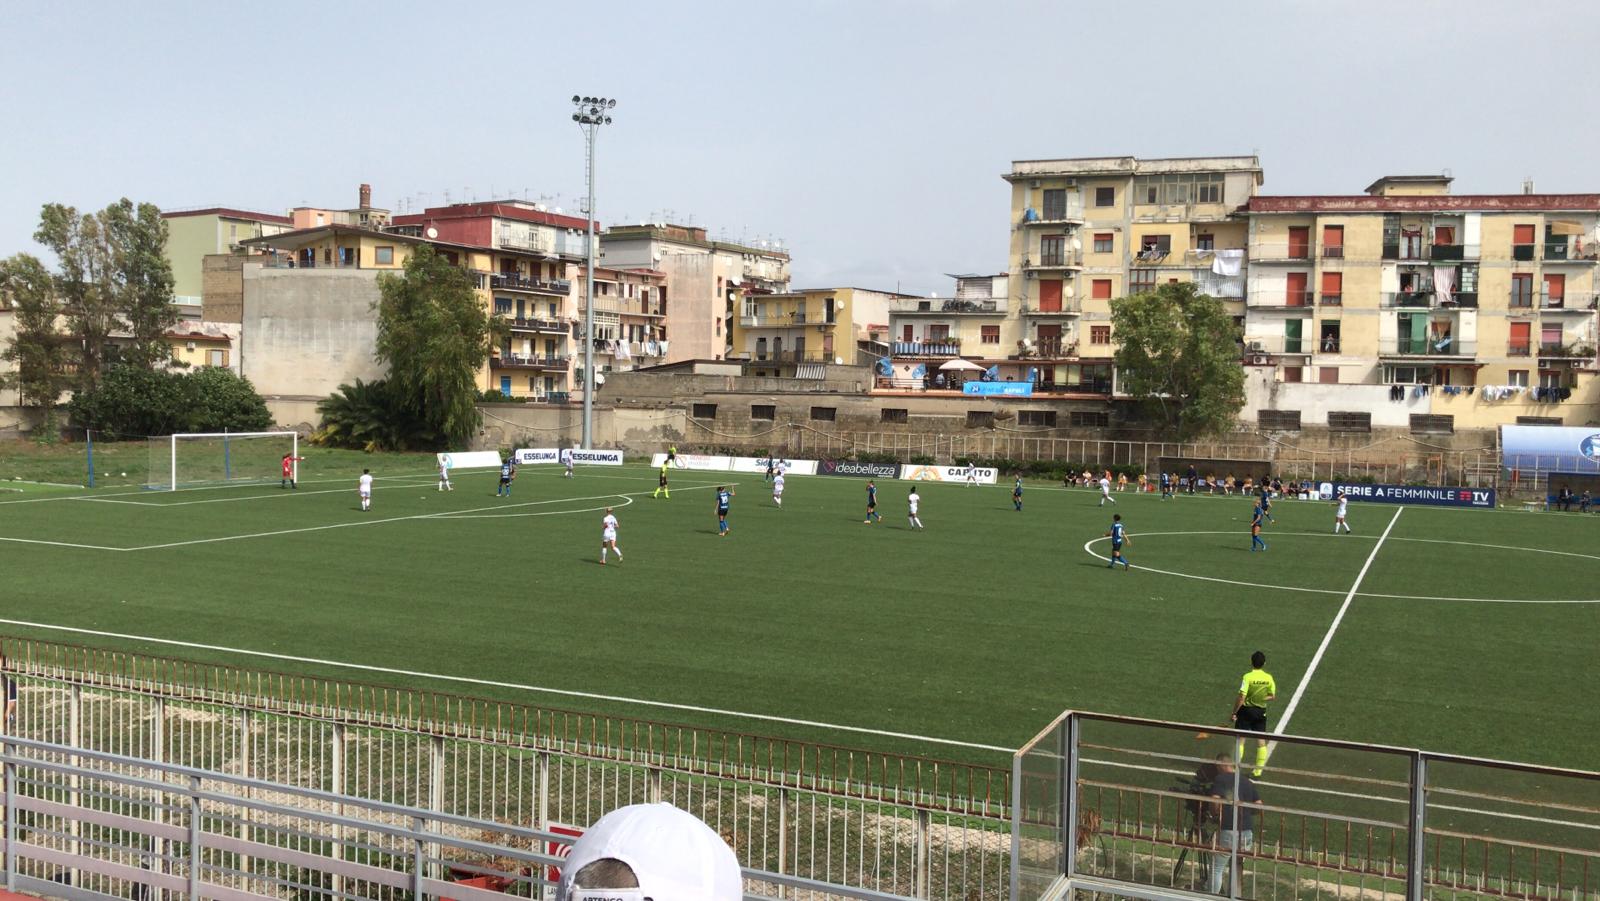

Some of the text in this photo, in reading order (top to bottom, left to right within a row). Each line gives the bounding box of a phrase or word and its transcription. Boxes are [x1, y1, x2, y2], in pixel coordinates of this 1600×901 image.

[523, 452, 556, 460] ESSELUNGA
[572, 453, 619, 462] ESSELUNGA
[755, 458, 791, 468] Sidraba
[835, 462, 896, 475] ideabellezza
[1337, 485, 1489, 502] SERIE A FEMMINILE TV
